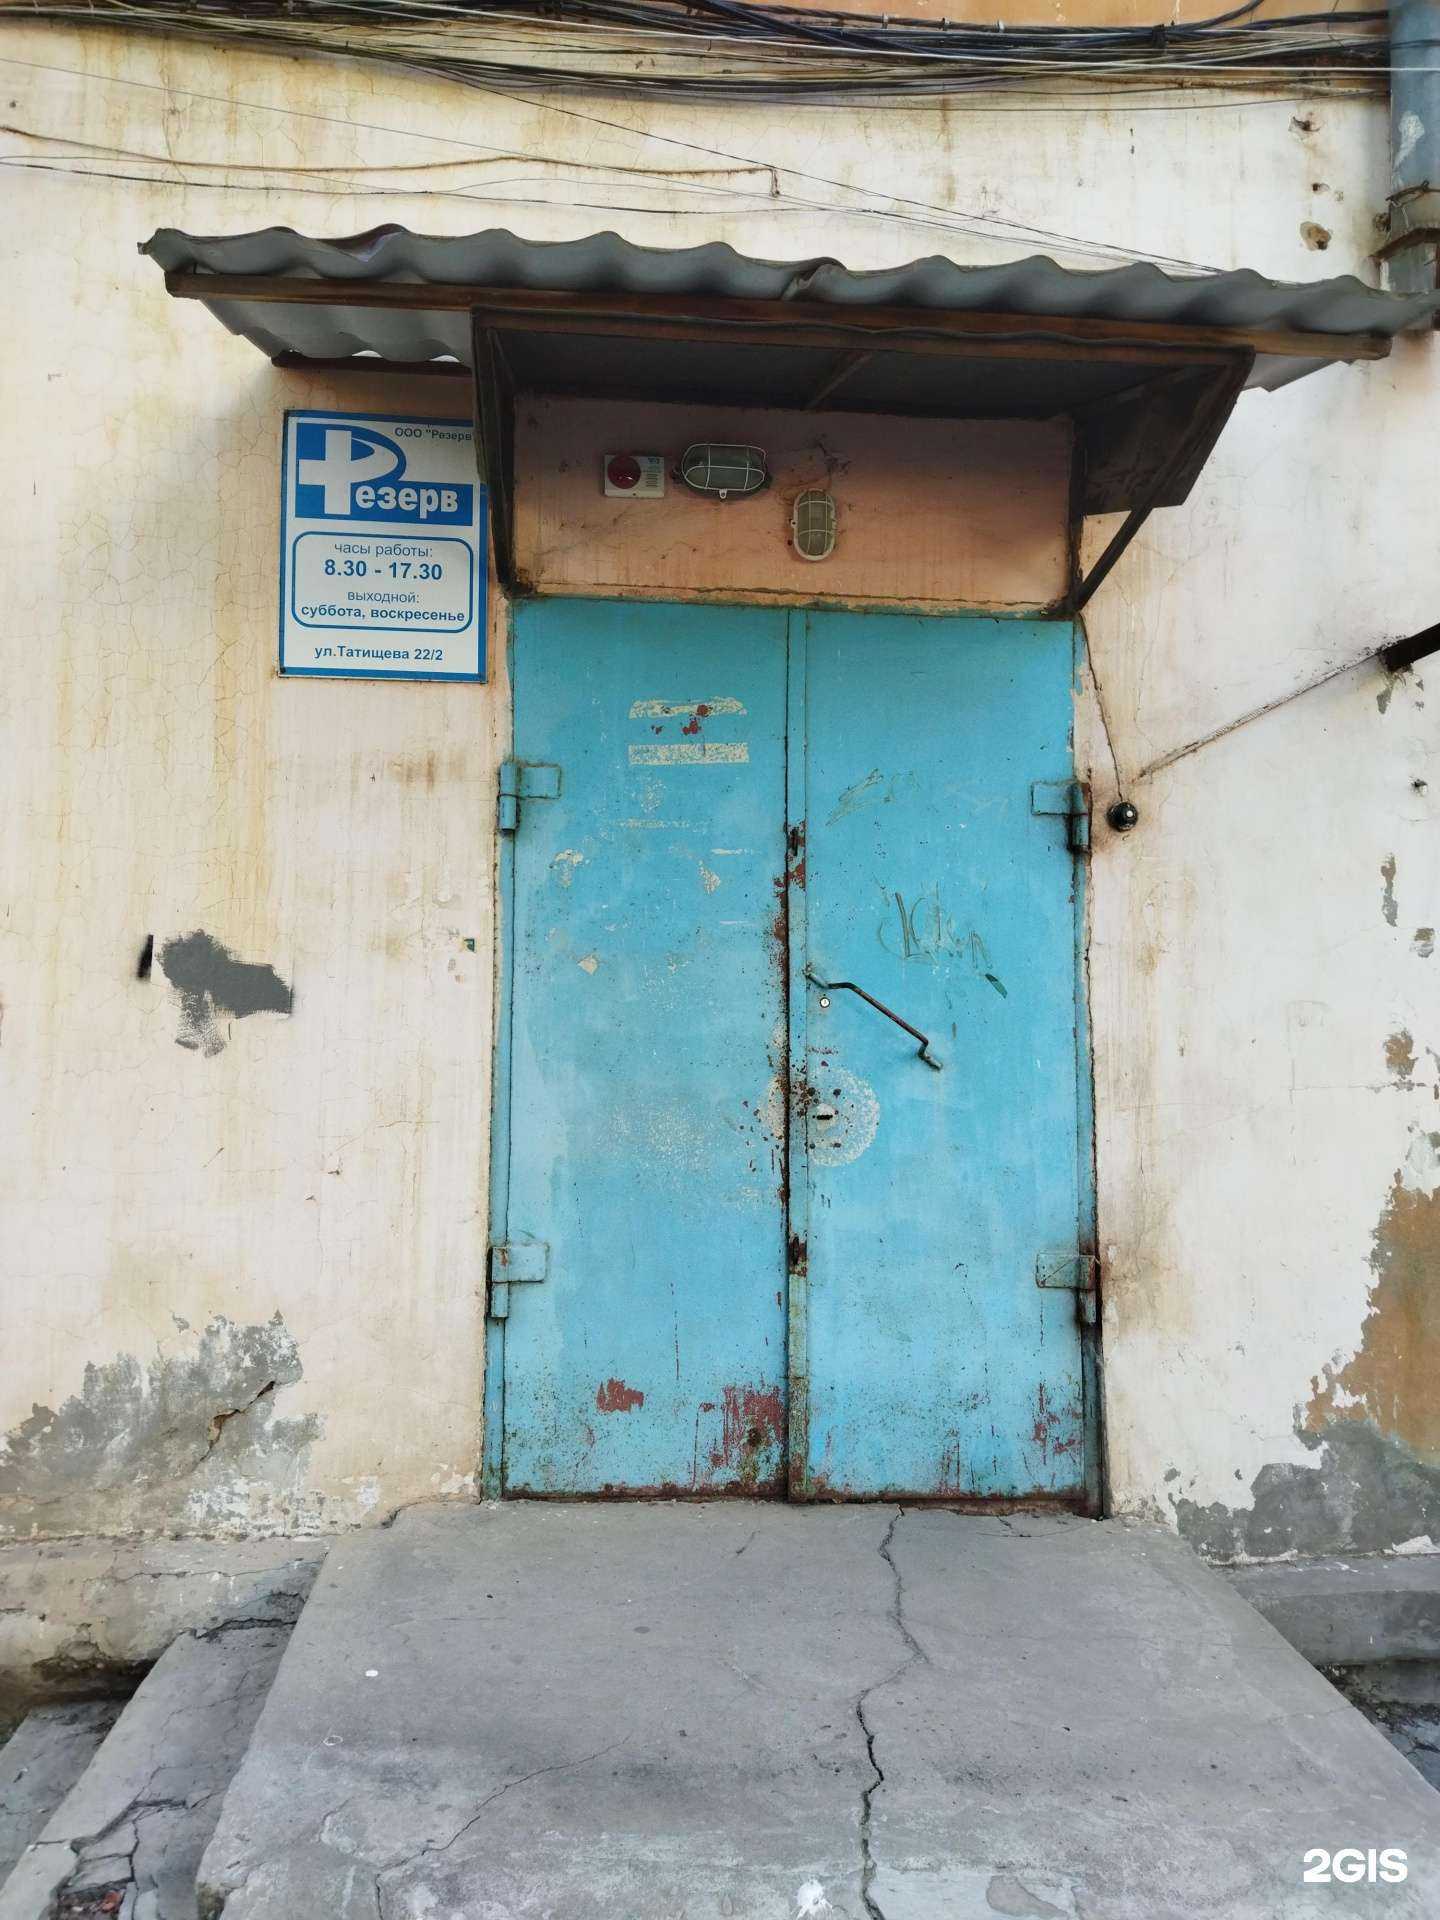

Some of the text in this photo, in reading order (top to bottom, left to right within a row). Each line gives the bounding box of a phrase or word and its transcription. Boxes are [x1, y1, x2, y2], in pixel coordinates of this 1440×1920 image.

[394, 427, 422, 438] ООО
[334, 543, 433, 557] часы работы:
[324, 558, 367, 577] 8.30
[389, 561, 443, 580] 17.30
[347, 591, 420, 604] выходной:
[301, 604, 465, 621] суббота, воскресенье
[314, 645, 443, 661] ул.Татищева 22/2
